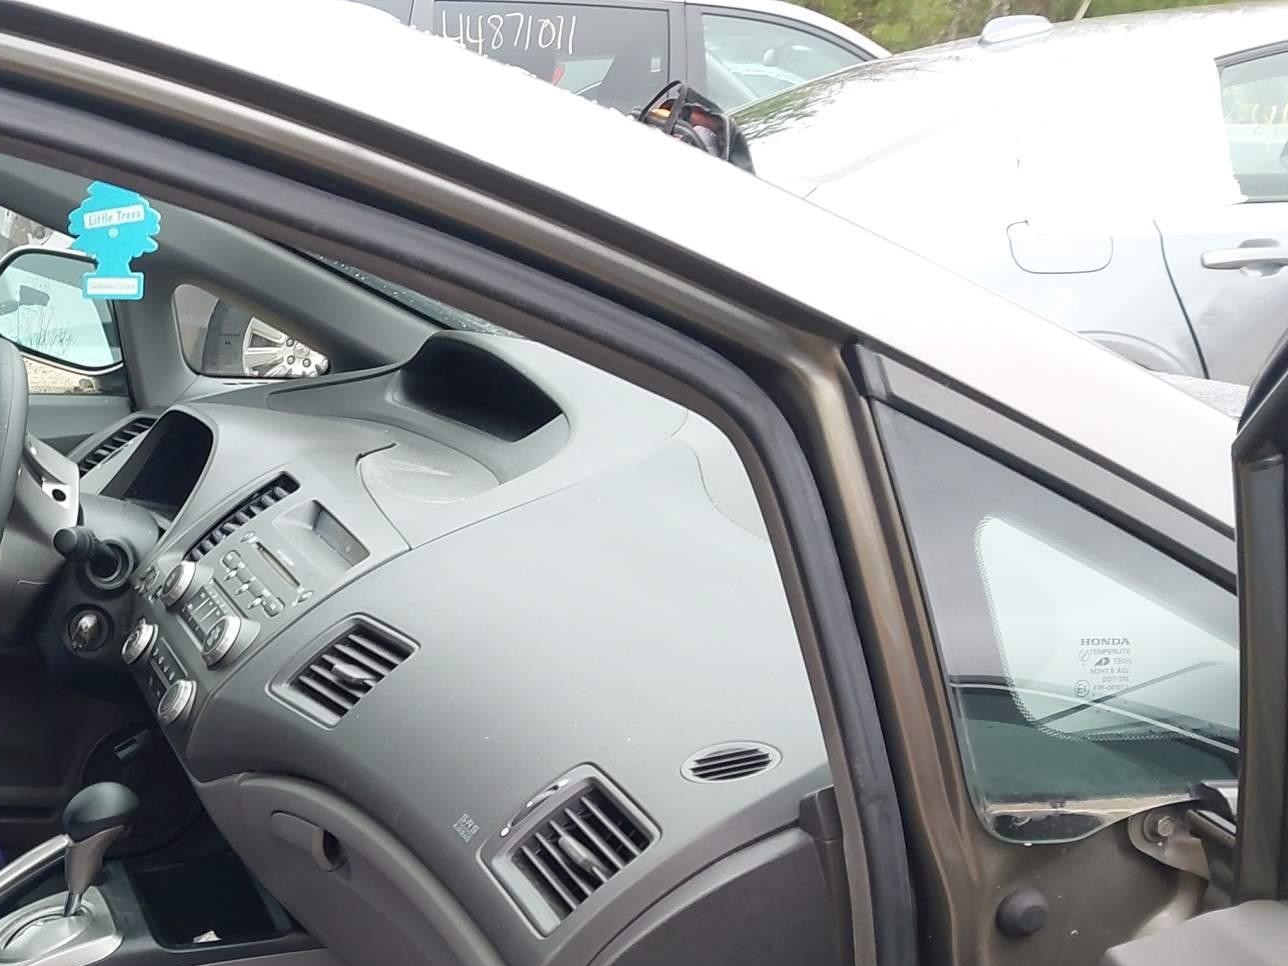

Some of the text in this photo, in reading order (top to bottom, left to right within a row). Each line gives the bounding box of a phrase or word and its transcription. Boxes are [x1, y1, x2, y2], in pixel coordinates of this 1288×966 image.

[88, 209, 142, 227] Little Trees
[1080, 638, 1130, 646] HONDA
[460, 813, 480, 835] SRS
